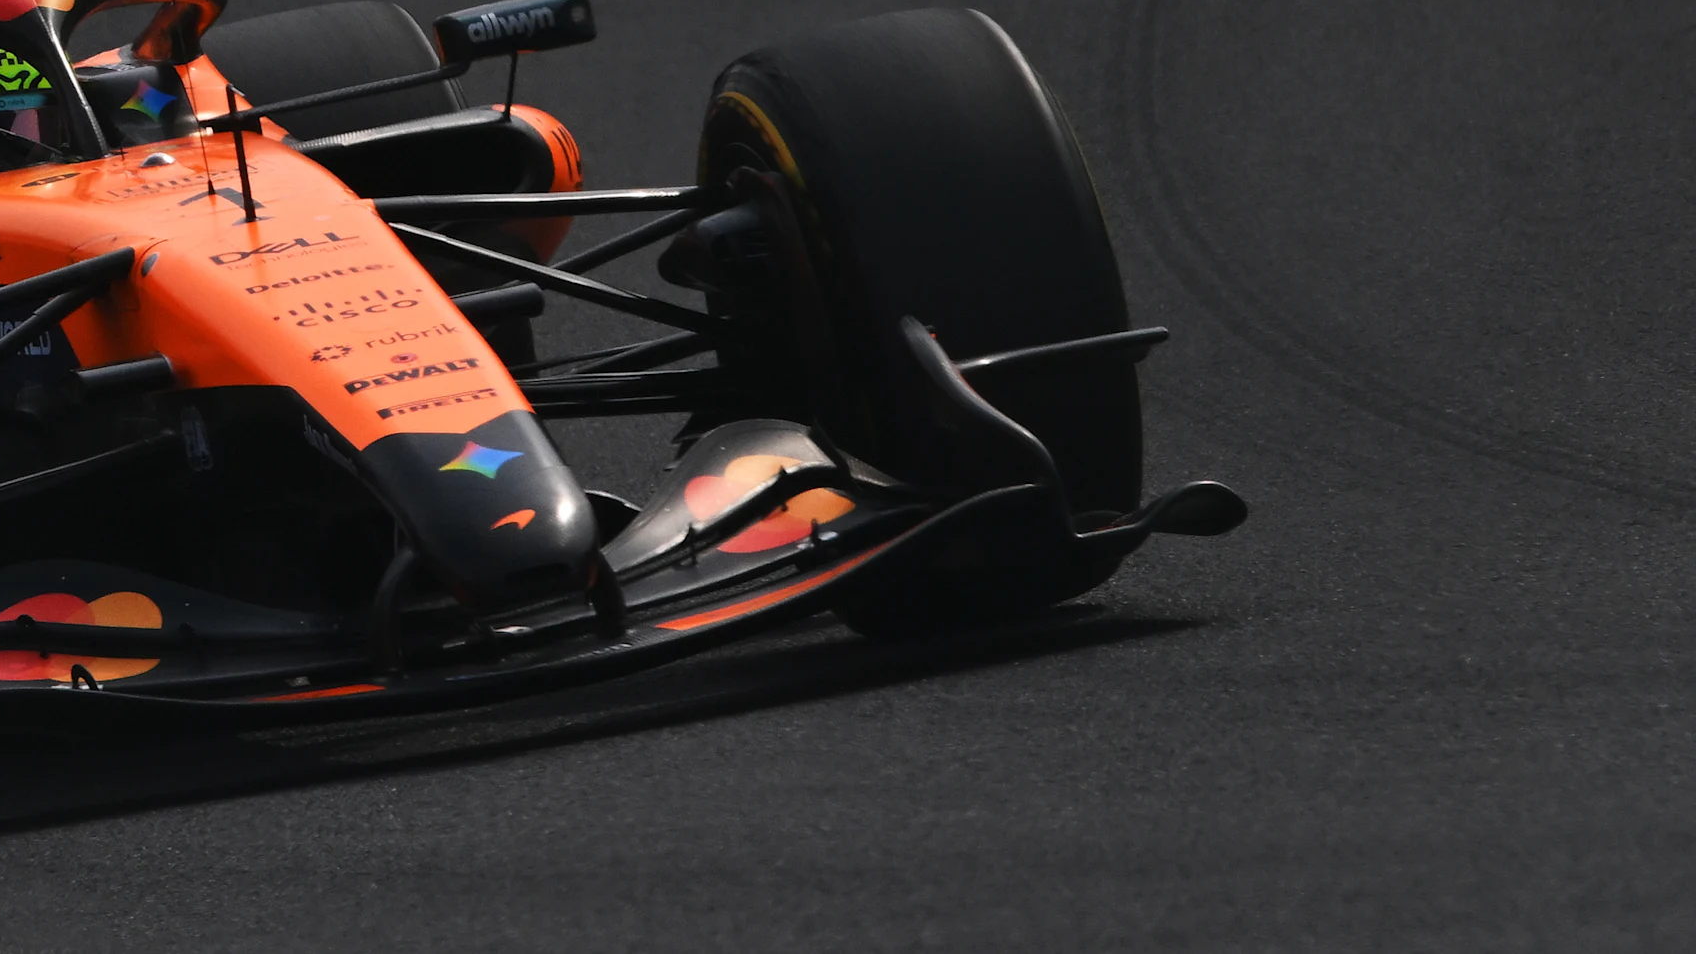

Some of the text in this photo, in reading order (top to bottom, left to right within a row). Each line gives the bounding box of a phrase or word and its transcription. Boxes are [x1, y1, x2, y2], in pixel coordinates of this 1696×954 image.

[467, 7, 554, 43] allwyn
[209, 232, 360, 265] DELL
[365, 323, 459, 349] rubrik
[376, 387, 498, 420] PIRELLI
